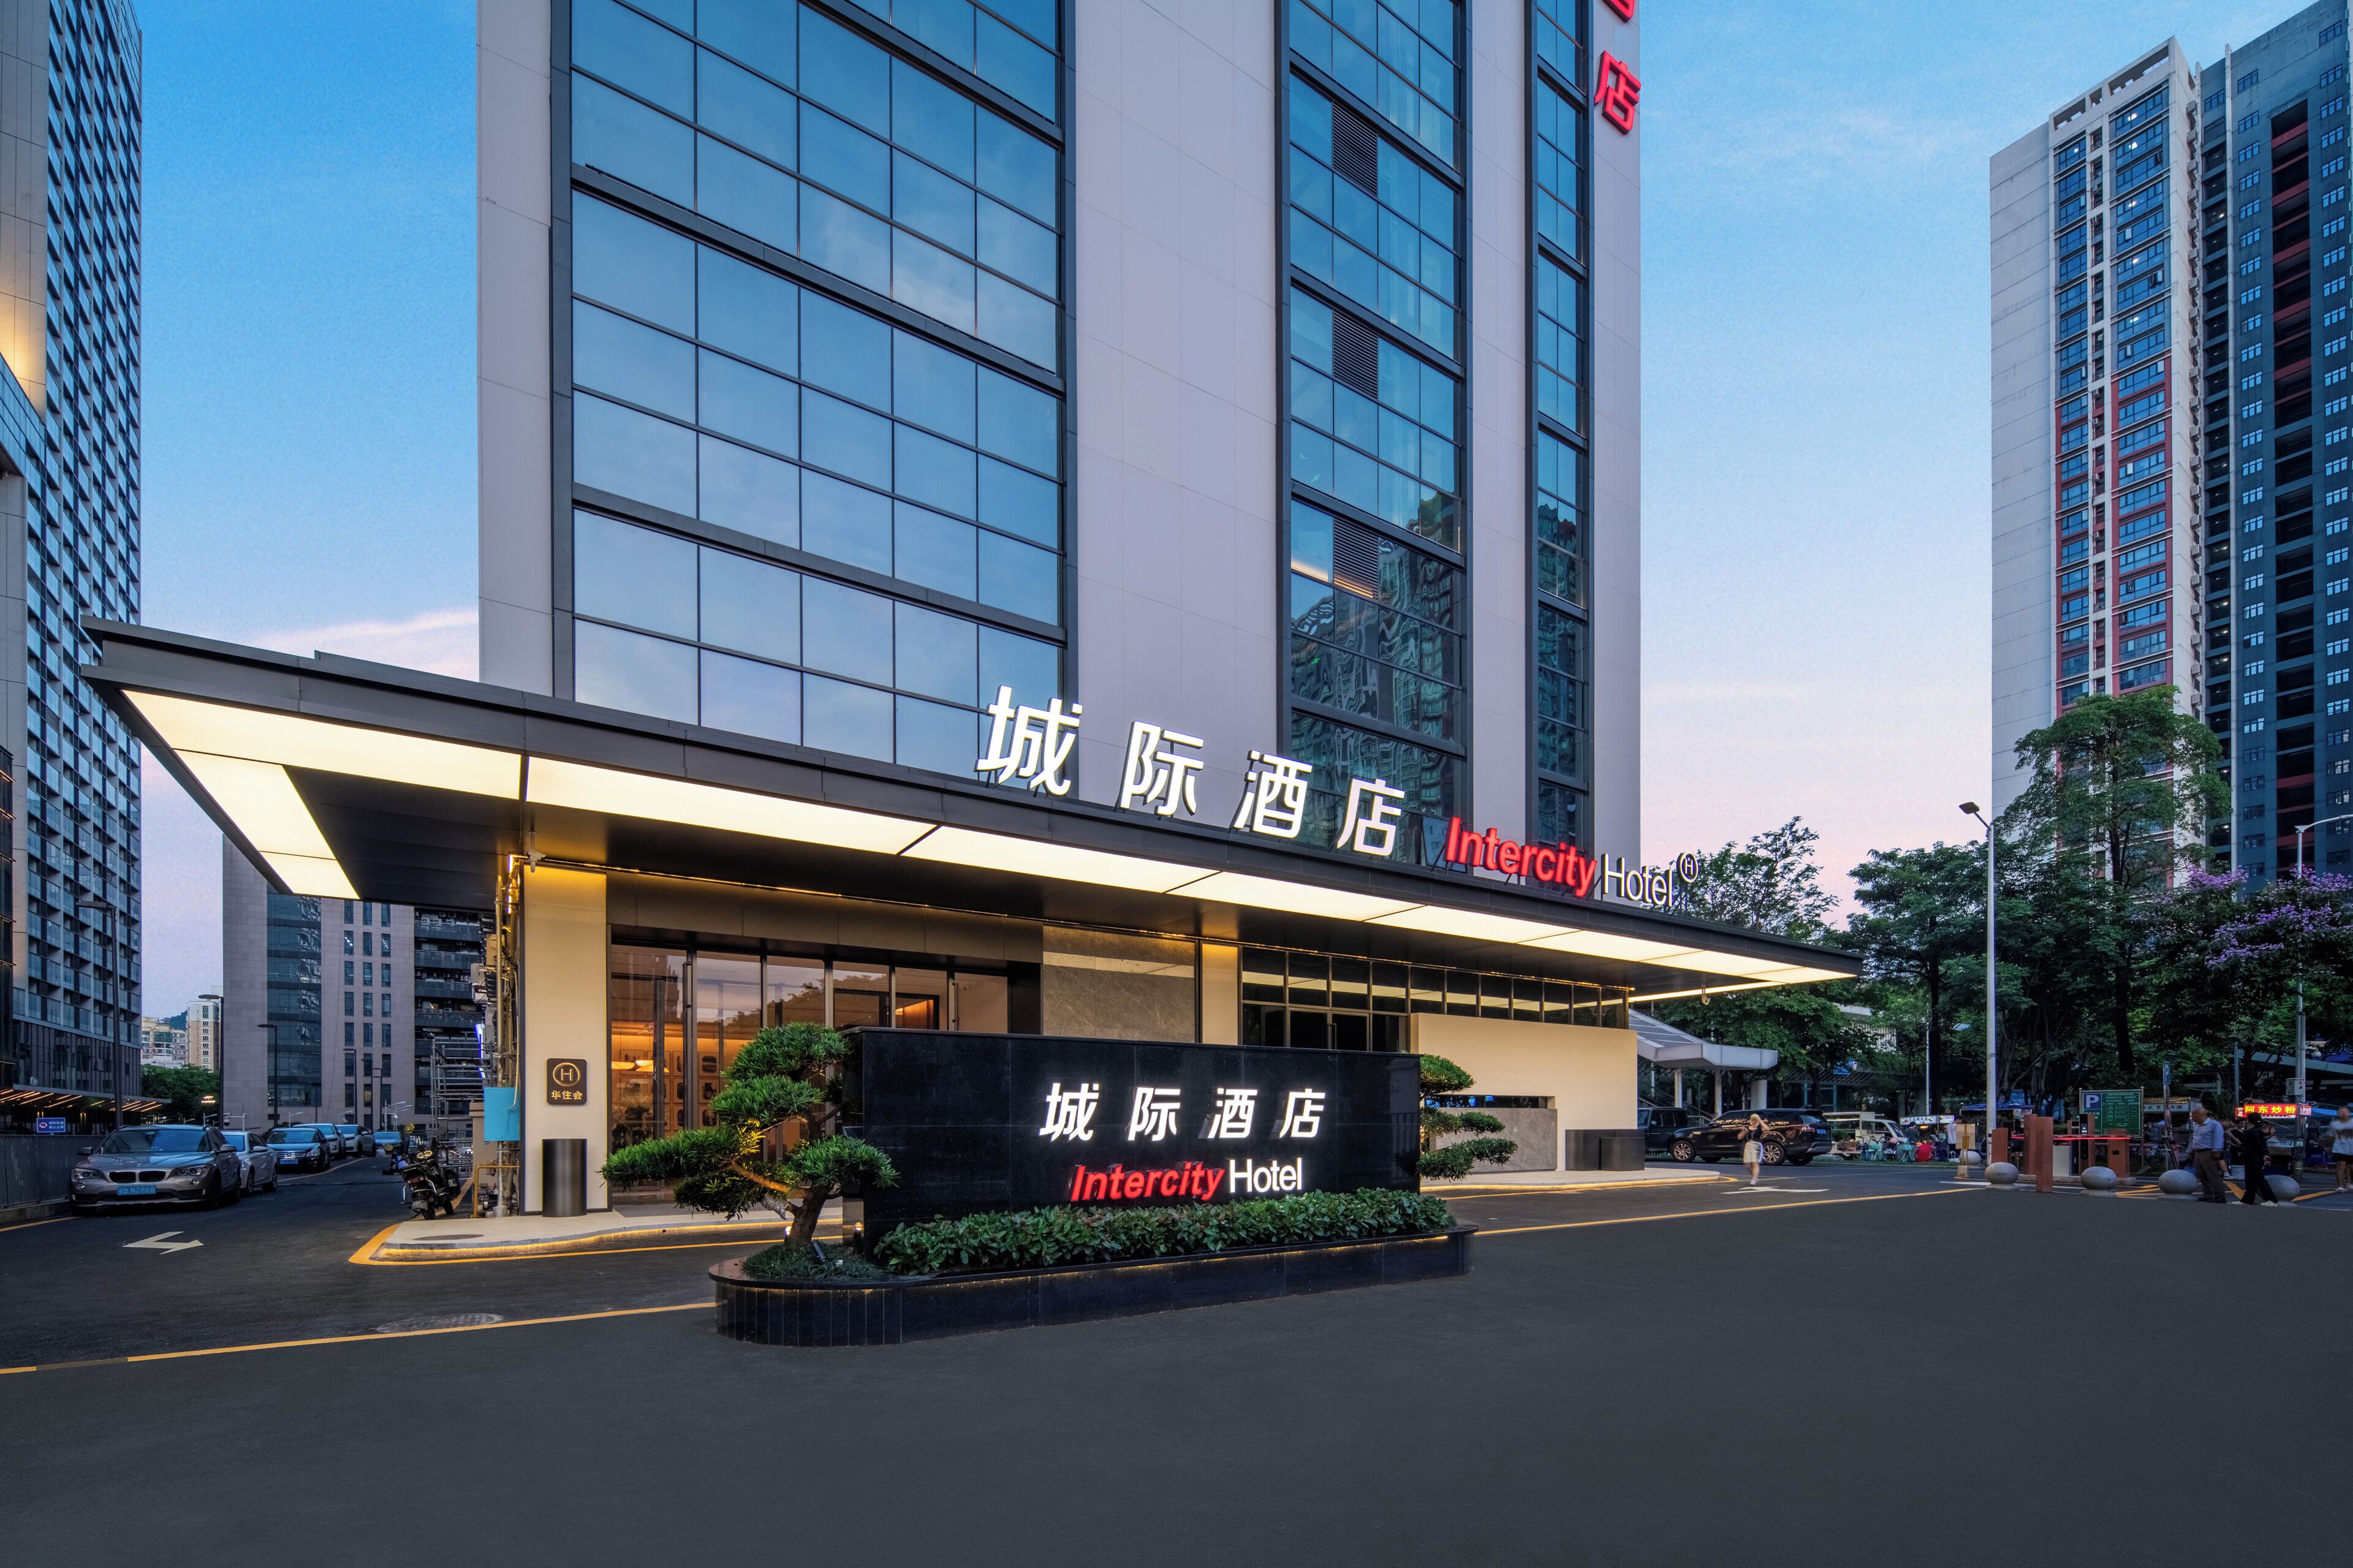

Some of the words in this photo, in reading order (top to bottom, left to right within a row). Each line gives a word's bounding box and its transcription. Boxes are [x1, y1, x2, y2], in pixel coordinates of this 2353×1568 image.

[974, 685, 1405, 856] 城际酒店
[1446, 817, 1597, 897] Intercity
[1601, 853, 1674, 907] Hotel
[551, 1090, 583, 1100] 华住会
[1039, 1083, 1325, 1142] 城际酒店
[2086, 1095, 2099, 1108] P
[2245, 1105, 2296, 1114] 阿东炒粉
[1070, 1162, 1225, 1201] Intercity
[1229, 1157, 1303, 1193] Hotel
